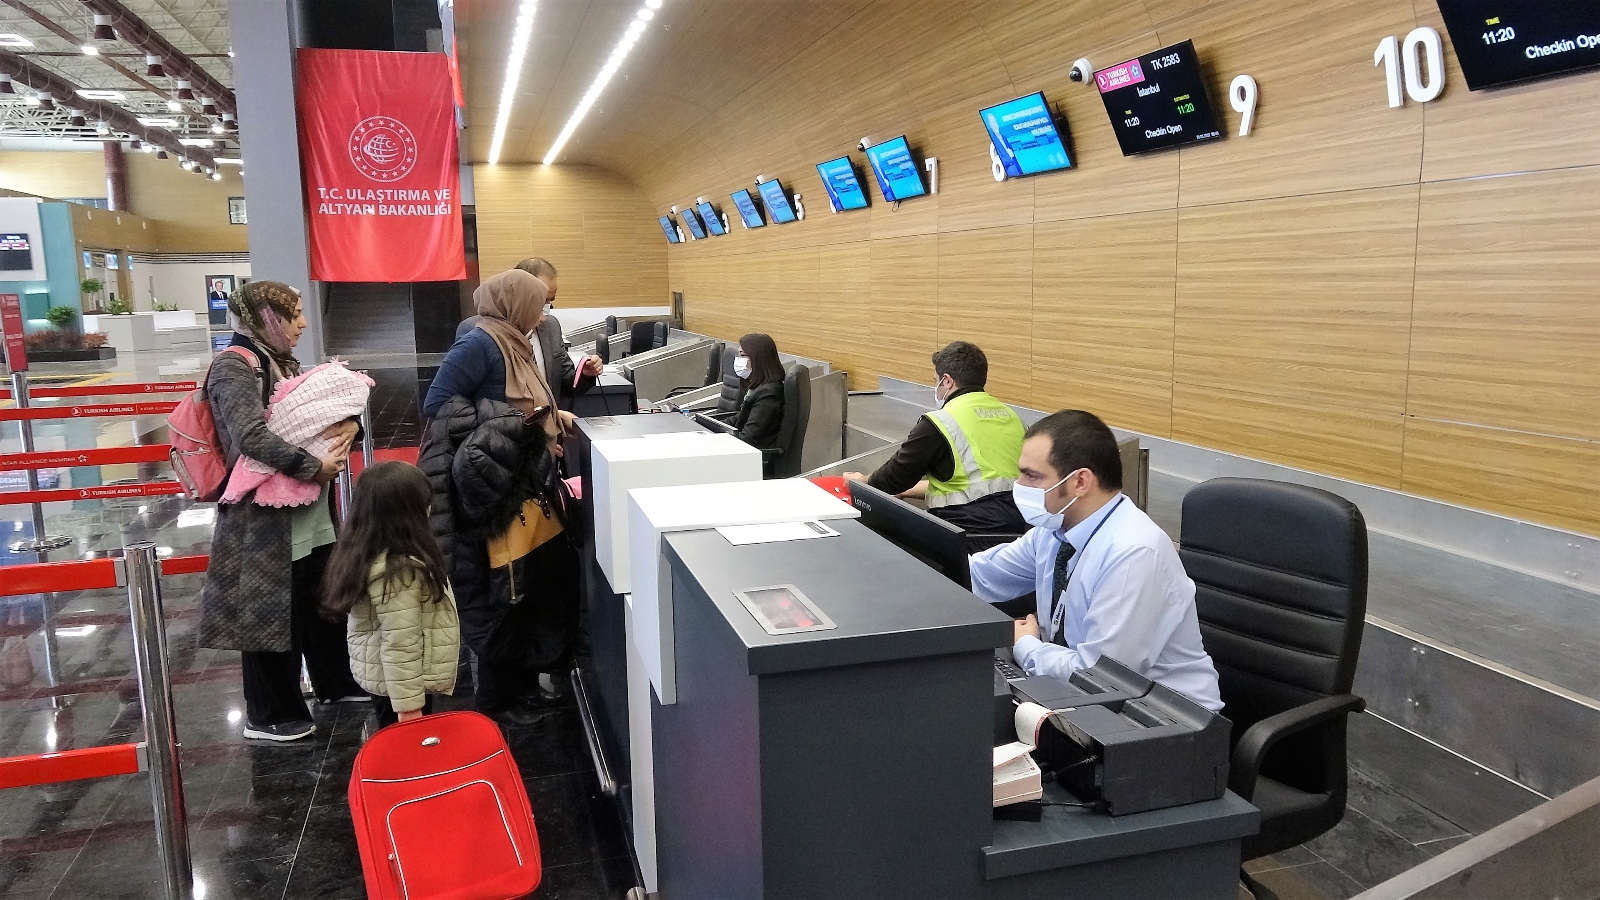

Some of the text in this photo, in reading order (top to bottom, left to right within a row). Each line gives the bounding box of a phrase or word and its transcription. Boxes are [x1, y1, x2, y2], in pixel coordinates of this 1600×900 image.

[1482, 26, 1516, 45] 11:20
[1525, 33, 1600, 59] Checkin Ope
[1151, 53, 1181, 71] TK 2583
[1373, 26, 1446, 108] 10
[1106, 67, 1129, 79] TURKISH
[1109, 75, 1131, 87] AIRLINES
[1177, 103, 1195, 115] 11:20
[1229, 74, 1257, 137] 9
[1125, 117, 1140, 127] 11:20
[1145, 124, 1183, 139] Checkin Open
[925, 156, 938, 194] 7
[318, 188, 450, 203] T.C. ULAŞTIRMA VE
[319, 202, 451, 216] ALTYAPI BAKANLIĞI
